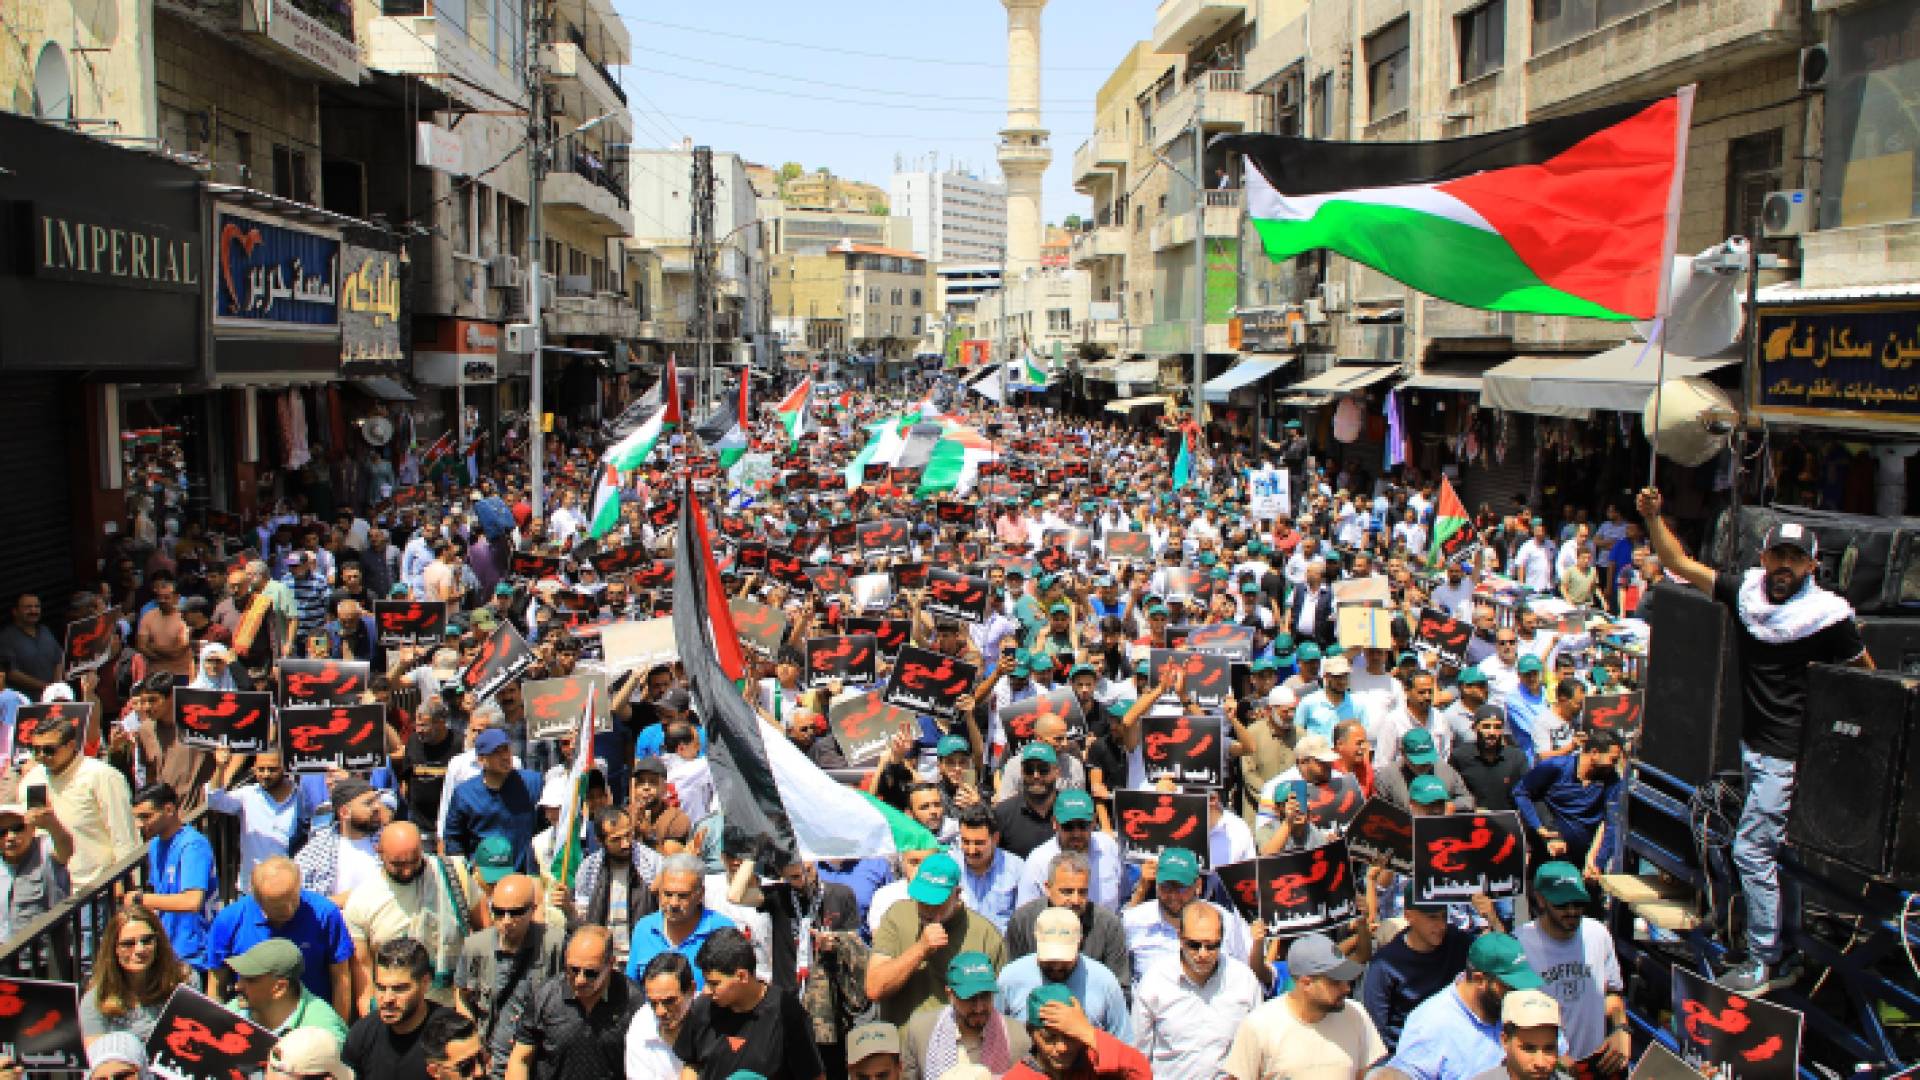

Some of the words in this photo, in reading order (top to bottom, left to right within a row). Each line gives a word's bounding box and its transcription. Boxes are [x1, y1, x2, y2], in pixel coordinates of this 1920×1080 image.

[41, 215, 198, 284] IMPERIAL
[293, 254, 336, 305] لمسة
[380, 600, 437, 630] رفح
[812, 637, 867, 671] رفح
[288, 663, 358, 697] رفح
[901, 658, 968, 695] رفح
[182, 692, 261, 730] رفح
[290, 708, 375, 752] رفح
[1146, 717, 1212, 761] رفح
[1123, 794, 1199, 840] رفح
[1427, 817, 1516, 873] رفح
[1270, 849, 1345, 908] رفح
[1682, 994, 1784, 1062] رفح
